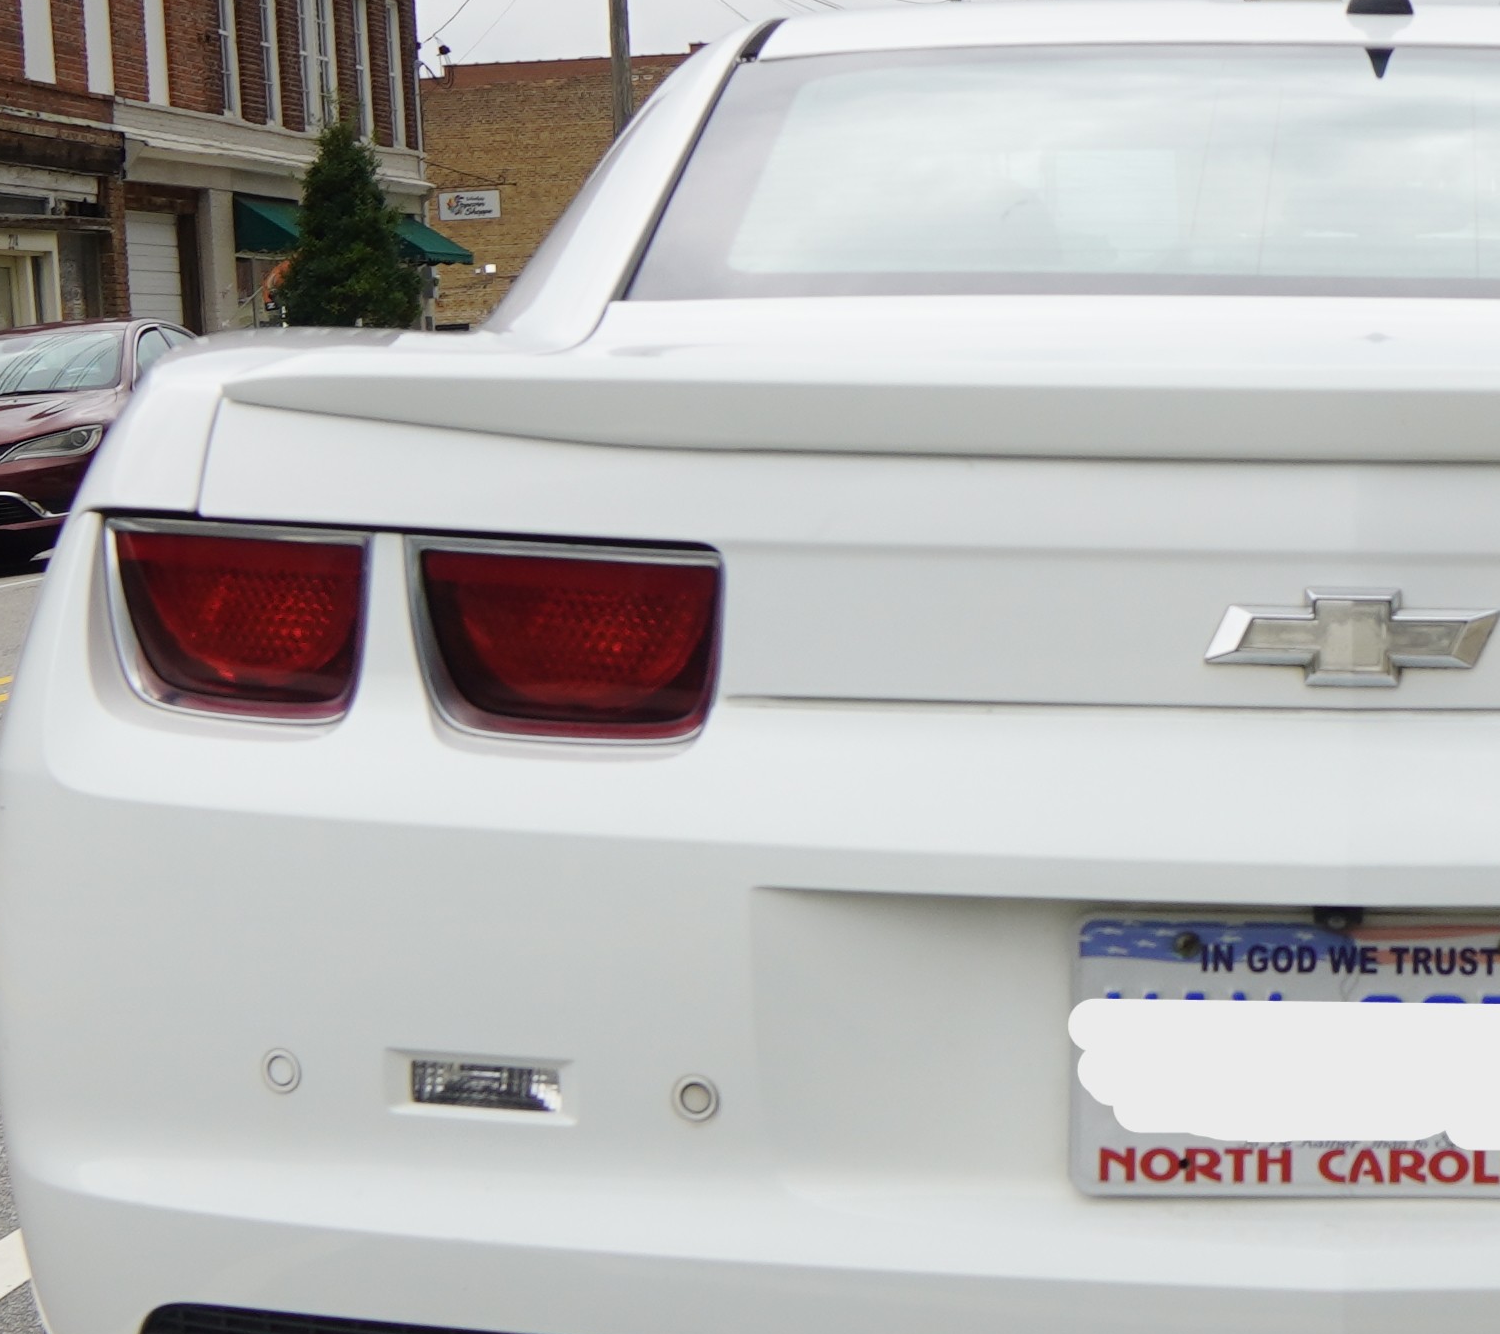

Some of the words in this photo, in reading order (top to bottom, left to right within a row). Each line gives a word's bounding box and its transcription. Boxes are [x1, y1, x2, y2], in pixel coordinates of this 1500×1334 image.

[1200, 944, 1234, 973] IN
[1246, 944, 1318, 975] GOD
[1328, 945, 1378, 976] WE
[1389, 946, 1499, 977] TRUST
[1098, 1147, 1292, 1183] NORTH
